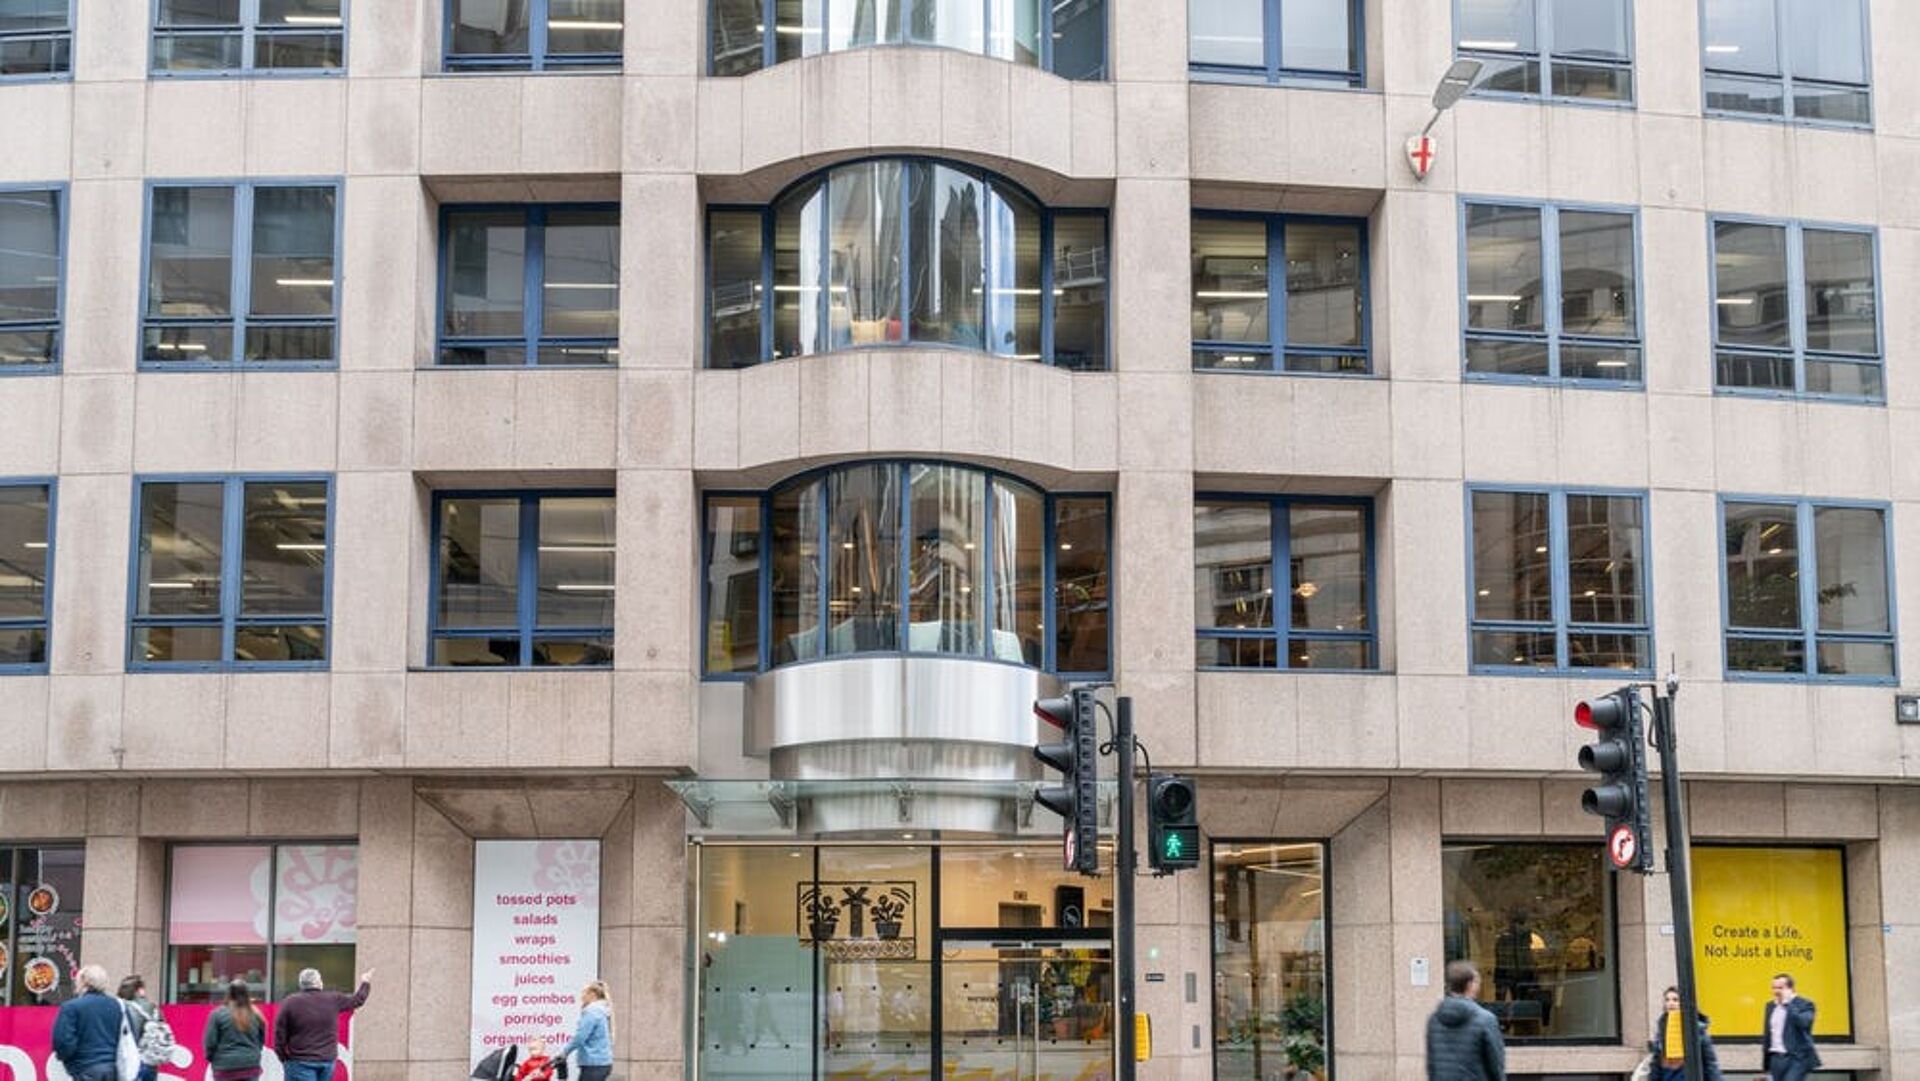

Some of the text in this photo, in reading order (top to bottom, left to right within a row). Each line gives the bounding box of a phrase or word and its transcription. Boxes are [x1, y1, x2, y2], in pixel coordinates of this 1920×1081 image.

[496, 894, 576, 907] tossed pots
[513, 913, 558, 924] salads
[1713, 925, 1758, 938] Create
[1763, 929, 1770, 938] a
[514, 935, 556, 947] wraps
[499, 953, 570, 965] smoothies
[1704, 945, 1813, 961] Not Just a Living
[514, 973, 555, 987] juices
[492, 993, 575, 1006] egg combos
[504, 1013, 562, 1027] porridge
